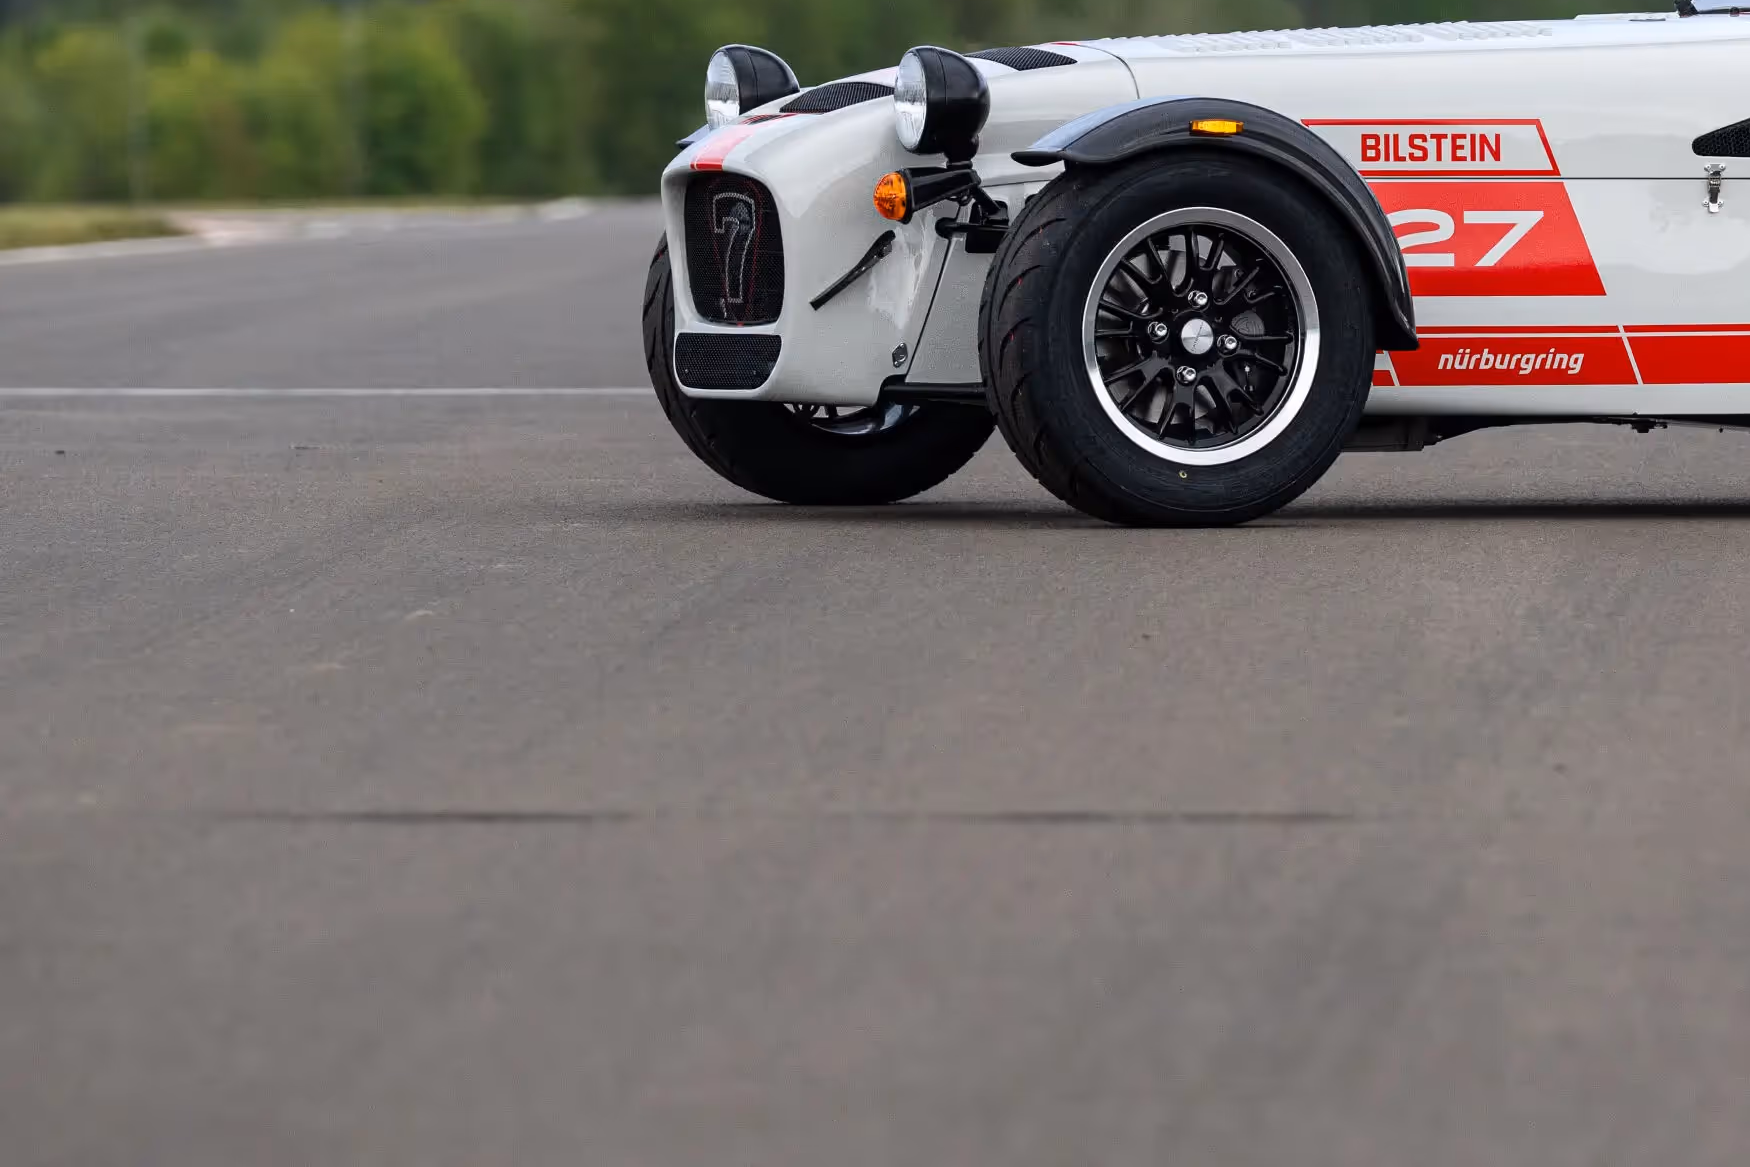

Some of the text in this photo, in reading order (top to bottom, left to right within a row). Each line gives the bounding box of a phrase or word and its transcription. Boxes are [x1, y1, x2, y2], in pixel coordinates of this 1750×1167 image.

[1360, 133, 1501, 162] BILSTEIN
[1386, 208, 1545, 267] 27
[1437, 348, 1585, 375] nürburgring
